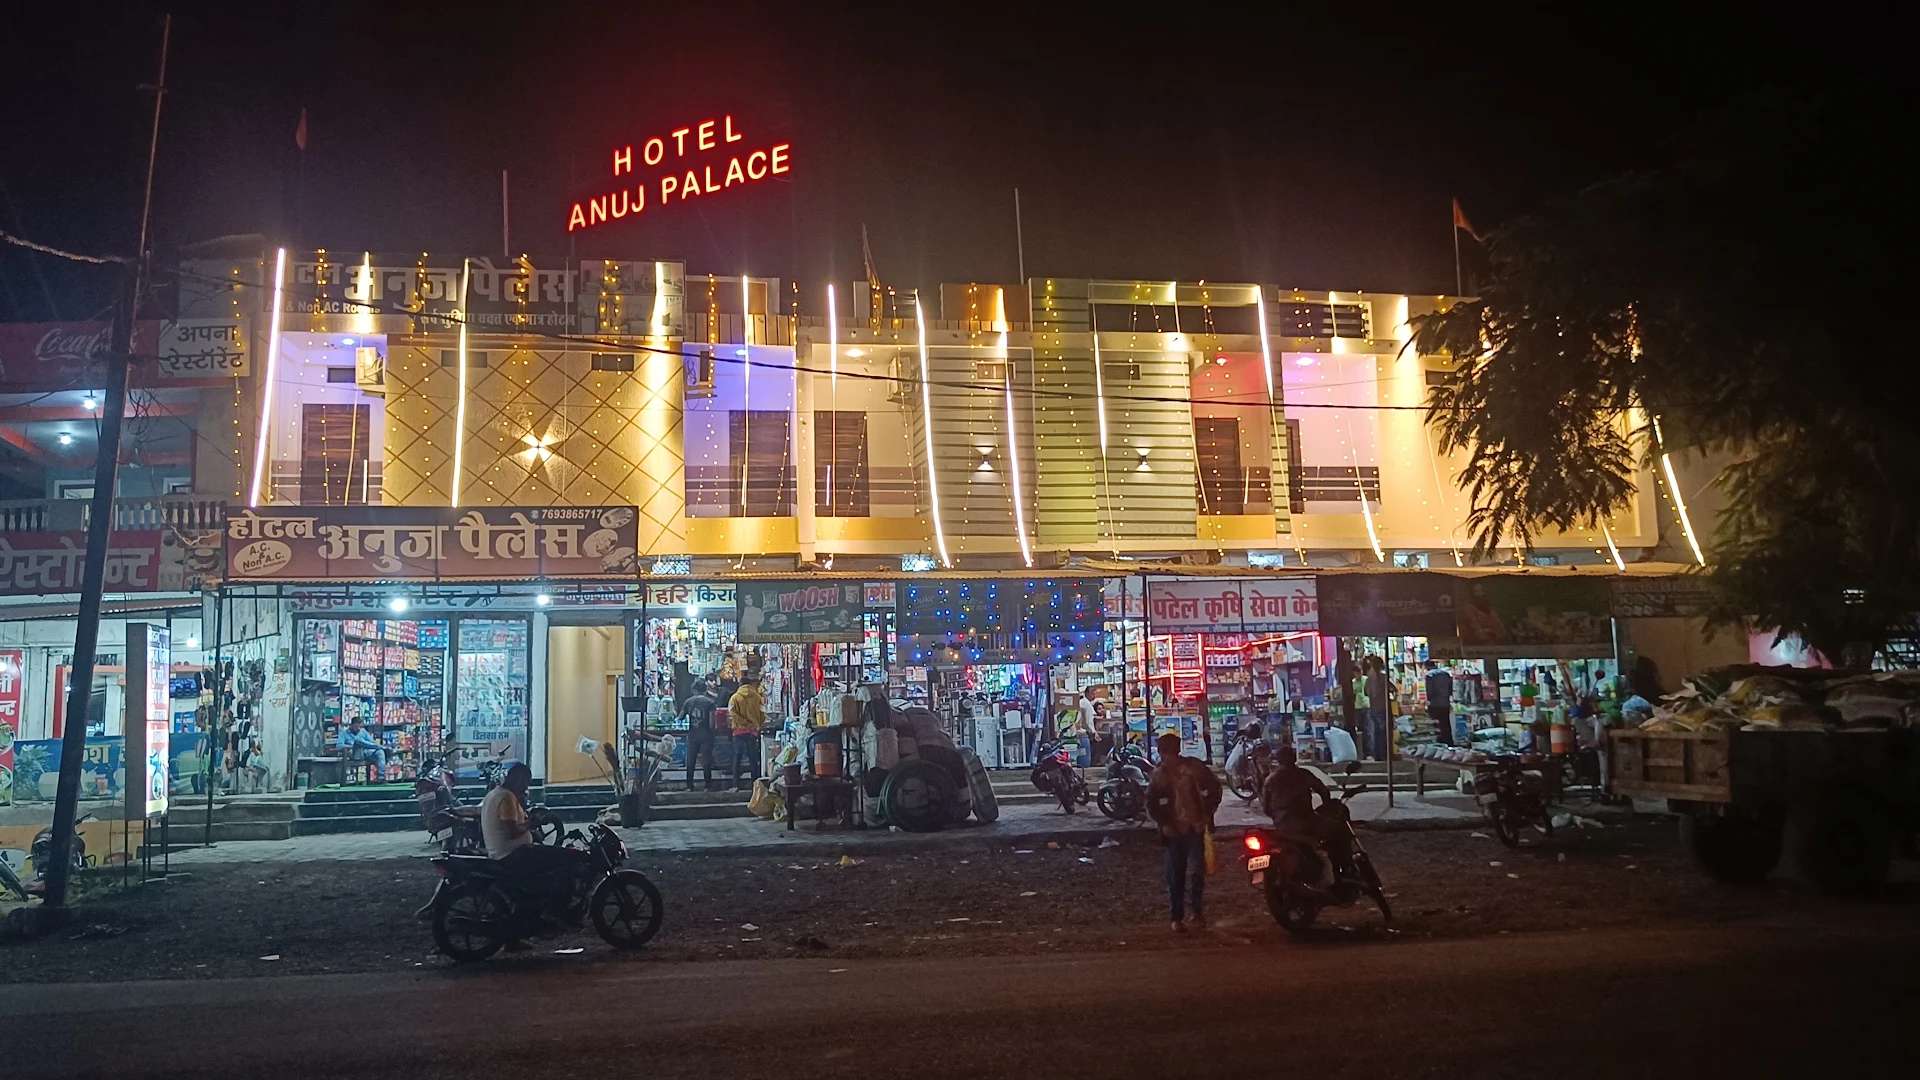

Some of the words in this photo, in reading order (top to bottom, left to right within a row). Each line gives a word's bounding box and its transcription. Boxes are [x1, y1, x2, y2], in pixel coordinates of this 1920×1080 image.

[613, 115, 743, 176] HOTEL
[567, 184, 646, 232] ANUJ
[660, 143, 791, 205] PALACE
[344, 264, 458, 311] अनुज
[469, 256, 578, 302] पैलेस
[298, 301, 321, 312] Non
[324, 301, 340, 313] AC
[178, 325, 238, 342] अपना
[541, 509, 602, 520] 7693865717
[227, 509, 319, 539] होटल
[318, 525, 449, 573] अनुज
[454, 510, 585, 560] पैलेस
[249, 542, 271, 556] A.C.
[242, 559, 262, 570] Non
[264, 551, 285, 563] A.C.
[655, 584, 693, 605] हरि
[779, 585, 840, 613] WOOSH
[1153, 591, 1200, 620] पटेल
[1203, 590, 1245, 623] कृषि
[1249, 589, 1288, 618] सेवा
[756, 633, 770, 642] HARI
[771, 633, 794, 642] KIRANA
[795, 633, 815, 642] STORE
